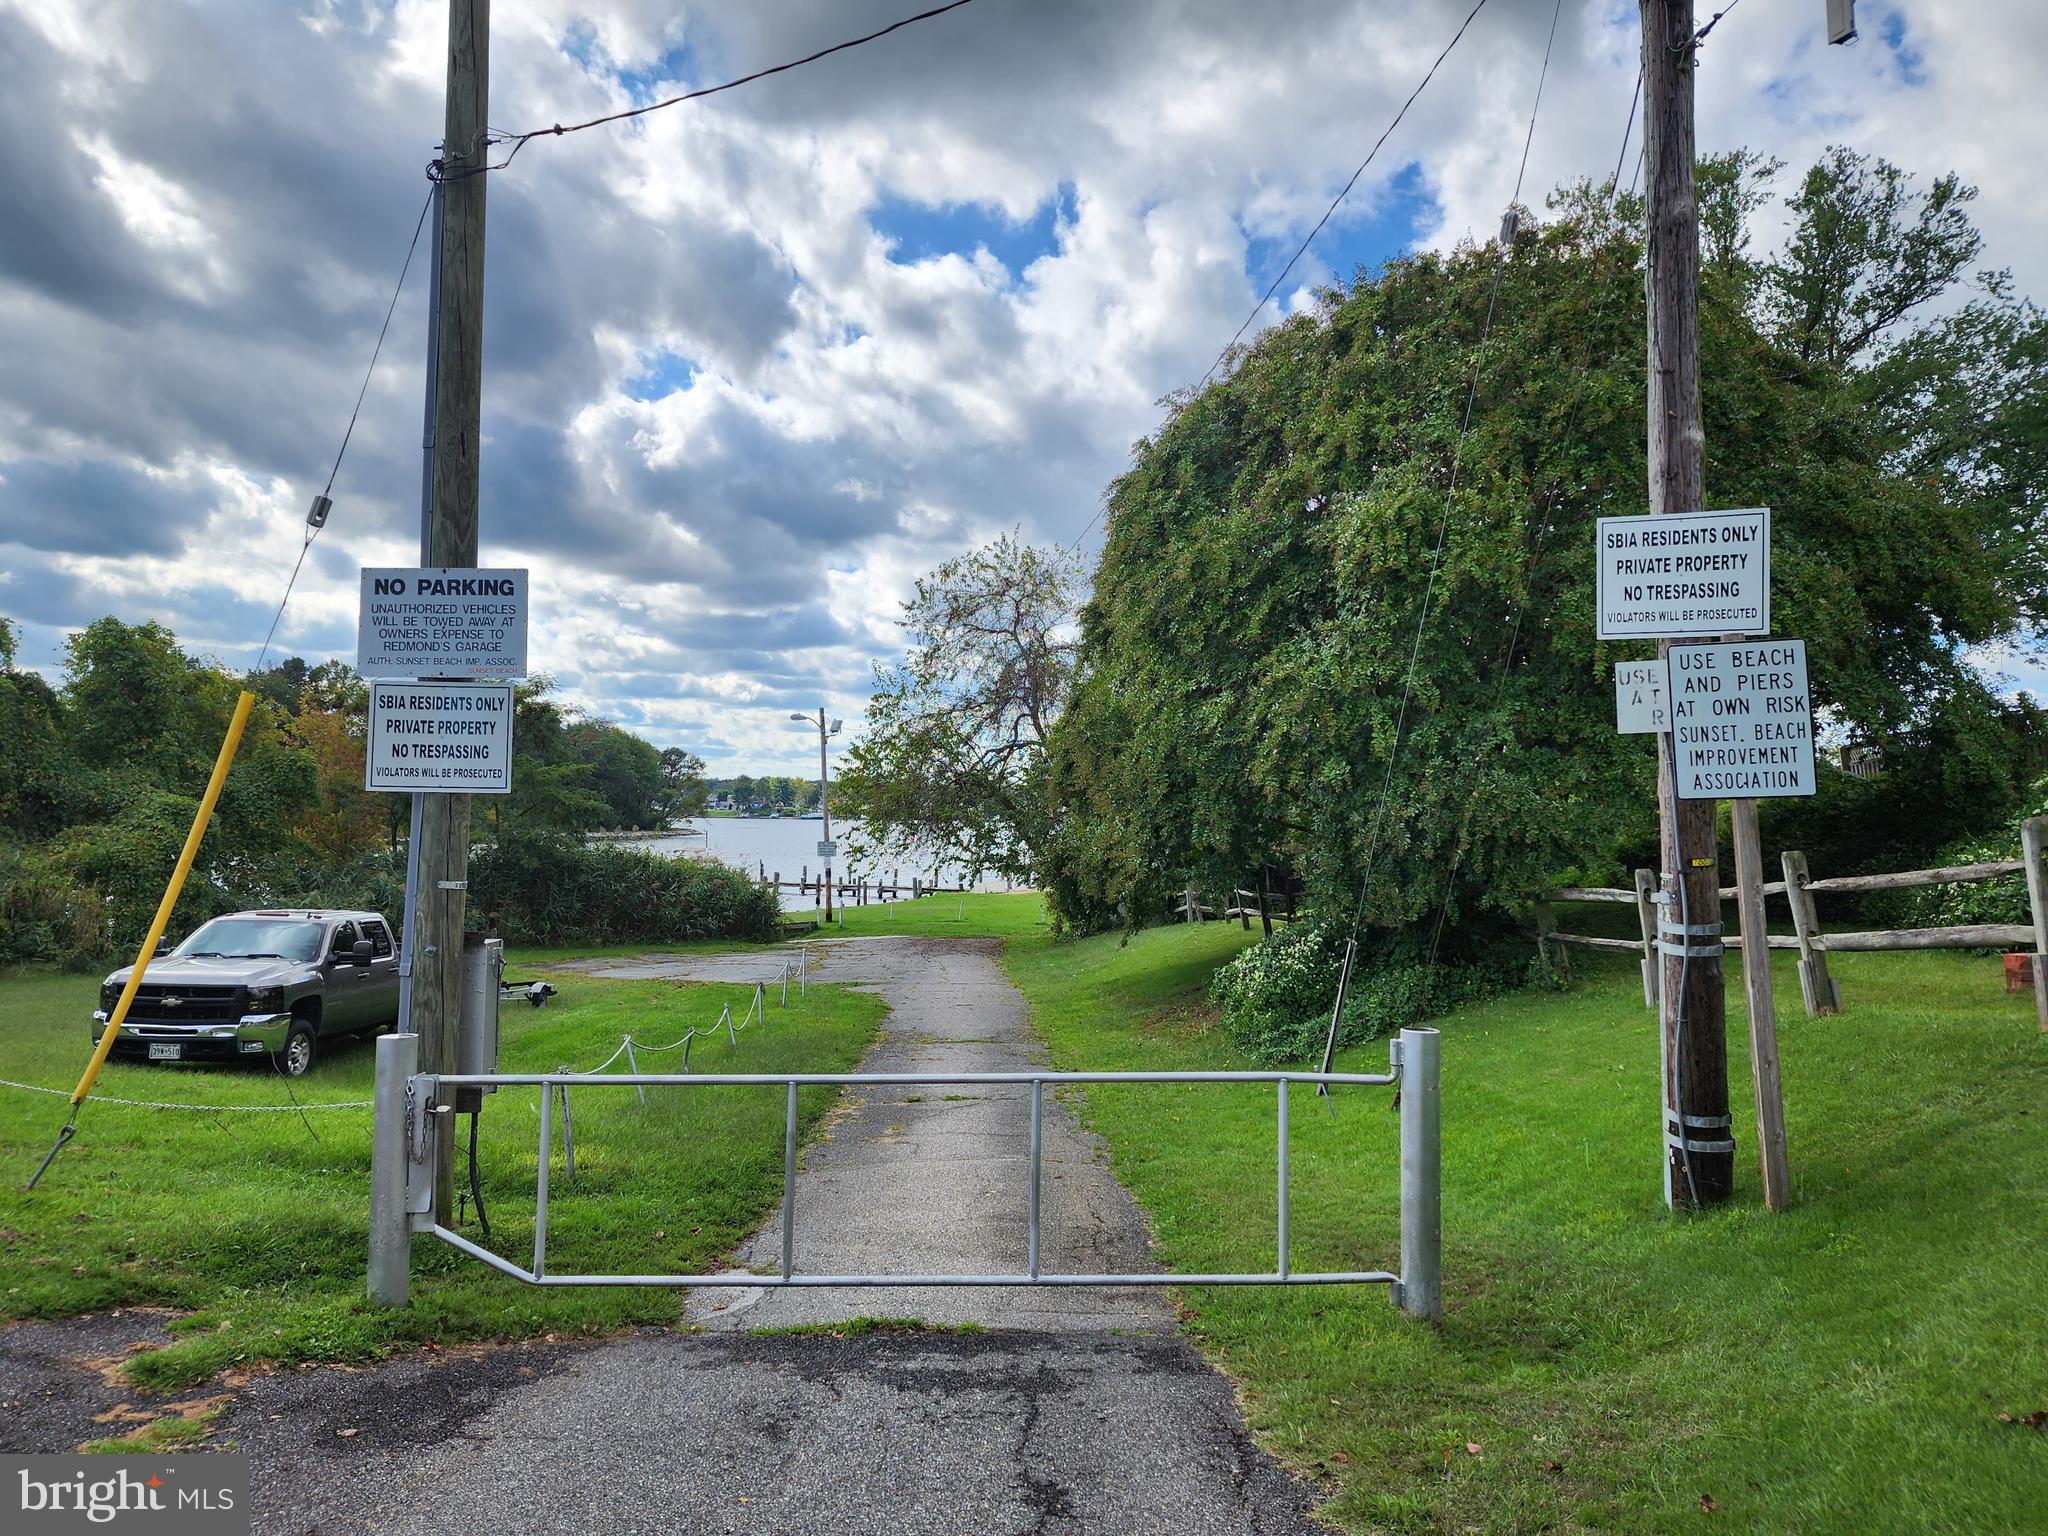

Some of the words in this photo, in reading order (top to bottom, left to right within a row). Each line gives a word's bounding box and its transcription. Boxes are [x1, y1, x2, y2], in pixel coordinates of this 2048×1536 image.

[1607, 533, 1637, 548] SBIA
[1642, 528, 1717, 546] RESIDENTS
[1722, 526, 1758, 542] ONLY
[1617, 558, 1671, 575] PRIVATE
[1676, 554, 1748, 572] PROPERTY
[374, 579, 405, 595] NO
[418, 579, 514, 596] PARKING
[1624, 586, 1643, 601] NO
[1647, 582, 1740, 600] TRESPASSING
[371, 604, 457, 614] UNAUTHORIZED
[463, 605, 516, 614] VEHICLES
[1608, 612, 1656, 623] VIOLATORS
[1659, 611, 1679, 621] WILL
[1683, 610, 1694, 620] BE
[1697, 608, 1757, 620] PROSECUTED
[372, 616, 398, 626] WILL
[403, 617, 417, 626] BE
[424, 617, 463, 627] TOWED
[469, 617, 496, 626] AWAY
[502, 617, 515, 626] AT
[379, 629, 428, 639] OWNERS
[433, 629, 484, 639] EXPENSE
[489, 630, 504, 639] TO
[384, 642, 450, 651] REDMOND'S
[455, 642, 502, 651] GARAGE
[368, 657, 392, 665] AUTH.
[396, 657, 430, 665] SUNSET
[1680, 653, 1715, 670] USE
[1732, 649, 1795, 668] BEACH
[1619, 669, 1658, 685] USE
[1685, 677, 1721, 693] AND
[1738, 673, 1793, 691] PIERS
[379, 695, 405, 709] SBIA
[410, 696, 472, 710] RESIDENTS
[476, 698, 505, 711] ONLY
[1676, 701, 1695, 717] AT
[1713, 698, 1749, 715] OWN
[1767, 696, 1806, 713] RISK
[386, 720, 434, 734] PRIVATE
[438, 721, 496, 735] PROPERTY
[1755, 722, 1806, 740] BEACH
[392, 744, 408, 758] NO
[412, 744, 489, 759] TRESPASSING
[1690, 747, 1798, 766] IMPROVEMENT
[376, 767, 419, 776] VIOLATORS
[422, 768, 439, 777] WILL
[442, 769, 451, 778] BE
[454, 769, 502, 778] PROSECUTED
[1694, 771, 1799, 790] ASSOCIATION
